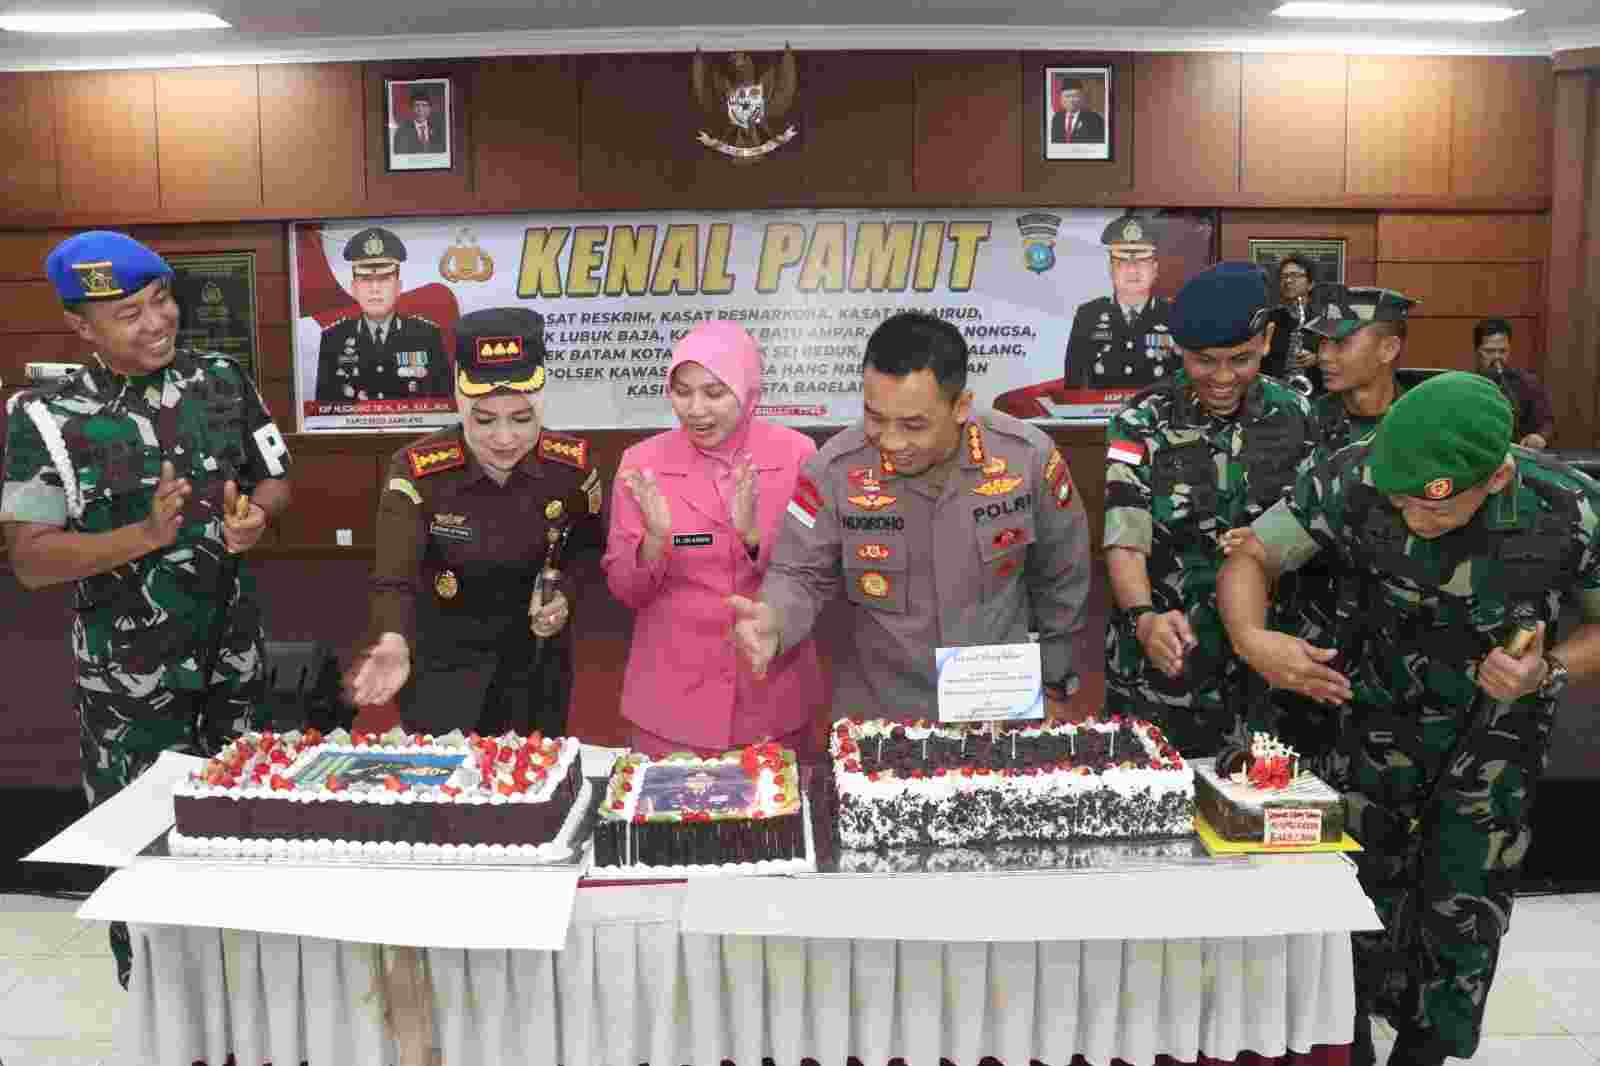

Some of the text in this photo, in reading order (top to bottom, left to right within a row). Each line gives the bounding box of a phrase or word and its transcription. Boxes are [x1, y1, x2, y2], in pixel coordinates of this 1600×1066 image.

[516, 220, 992, 298] KENAL PAMIT
[581, 311, 656, 325] RESKRIM,
[661, 309, 713, 323] KASAT
[839, 307, 889, 320] KASAT
[560, 331, 610, 344] LUBUK
[617, 330, 665, 344] BAJA,
[964, 325, 1037, 340] NONGSA,
[544, 350, 566, 361] EK
[569, 349, 625, 361] BATAM
[968, 344, 1027, 358] ALANG,
[609, 366, 668, 379] KAWAS
[627, 384, 665, 396] KASI
[760, 382, 789, 393] STA
[973, 494, 1032, 523] POLRI
